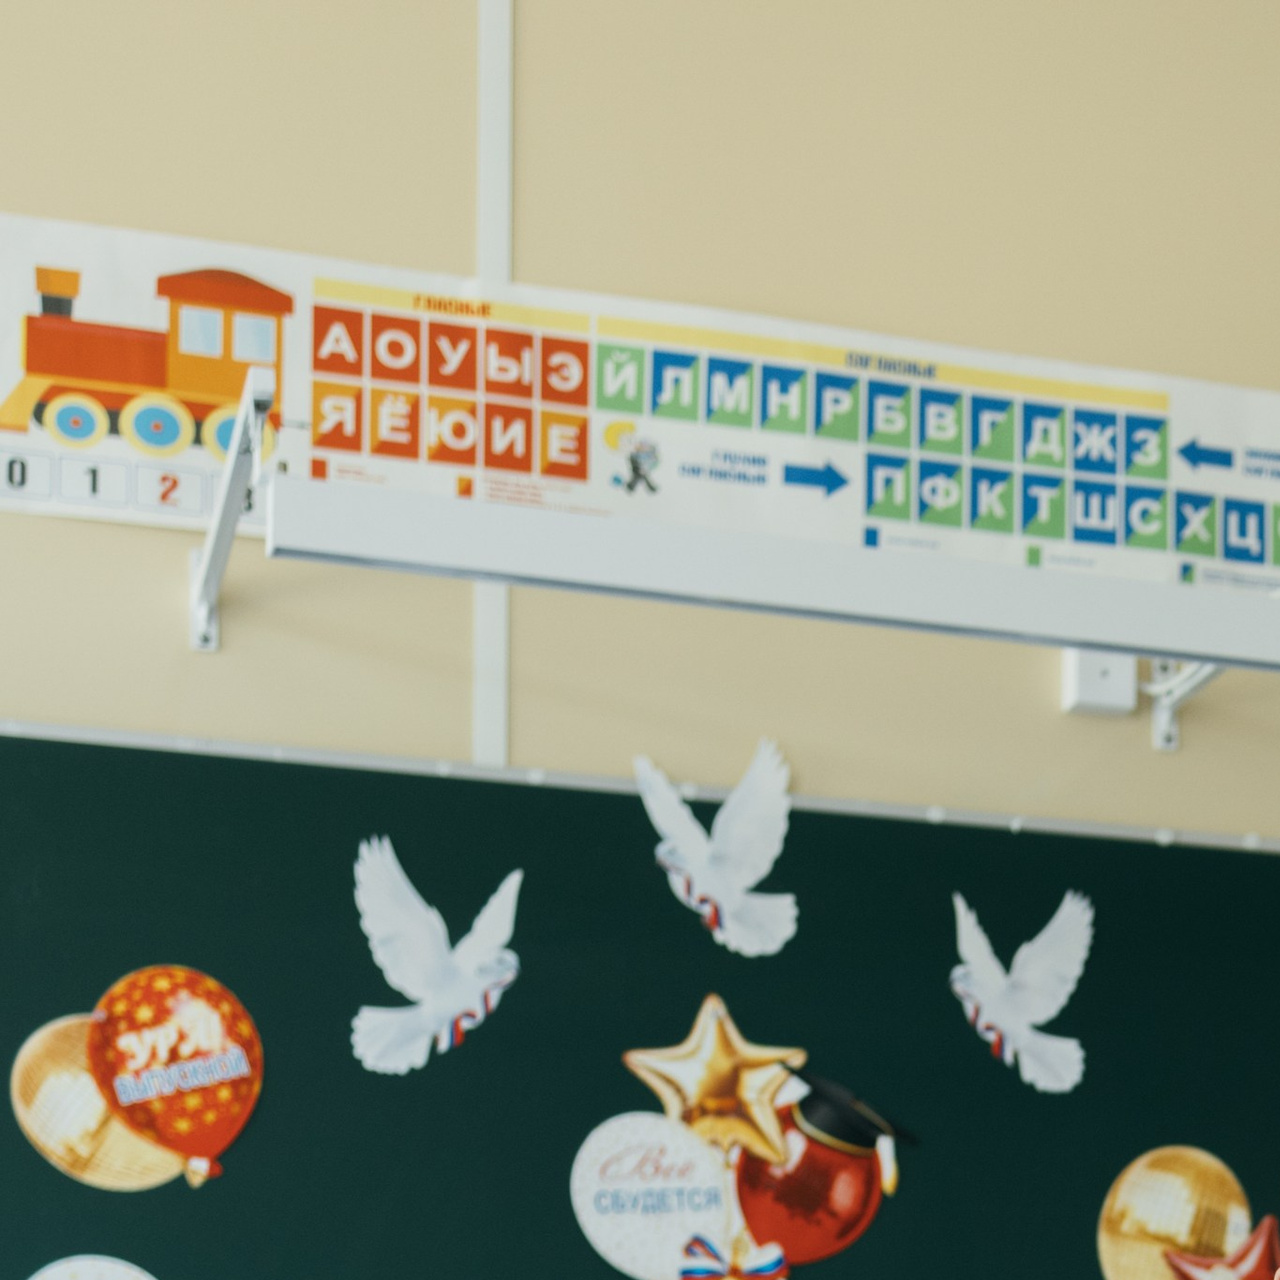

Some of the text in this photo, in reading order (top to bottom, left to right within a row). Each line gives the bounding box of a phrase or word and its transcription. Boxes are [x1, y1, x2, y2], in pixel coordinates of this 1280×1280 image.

[317, 321, 584, 393] А О У Ы Э
[319, 393, 580, 465] Я Ё Ю И Е
[656, 365, 693, 406] Л
[710, 371, 750, 415] М
[767, 378, 801, 420] Н
[820, 386, 853, 426] Р
[873, 394, 907, 434] Б
[925, 401, 959, 441] В
[977, 409, 1008, 447] Г
[1025, 416, 1064, 462] Д
[1072, 421, 1117, 462] Ж
[7, 458, 180, 506] 0 1 2
[873, 465, 907, 505] П
[920, 472, 961, 509] Ф
[977, 479, 1007, 519] К
[1027, 484, 1060, 523] Т
[1074, 490, 1117, 531] Ш
[1129, 497, 1163, 535] С
[1179, 503, 1212, 542] Х
[1226, 509, 1262, 556] Ц
[114, 1046, 251, 1107] ВЫПУСКНОЙ
[593, 1185, 722, 1216] СБУДЕТСЯ
